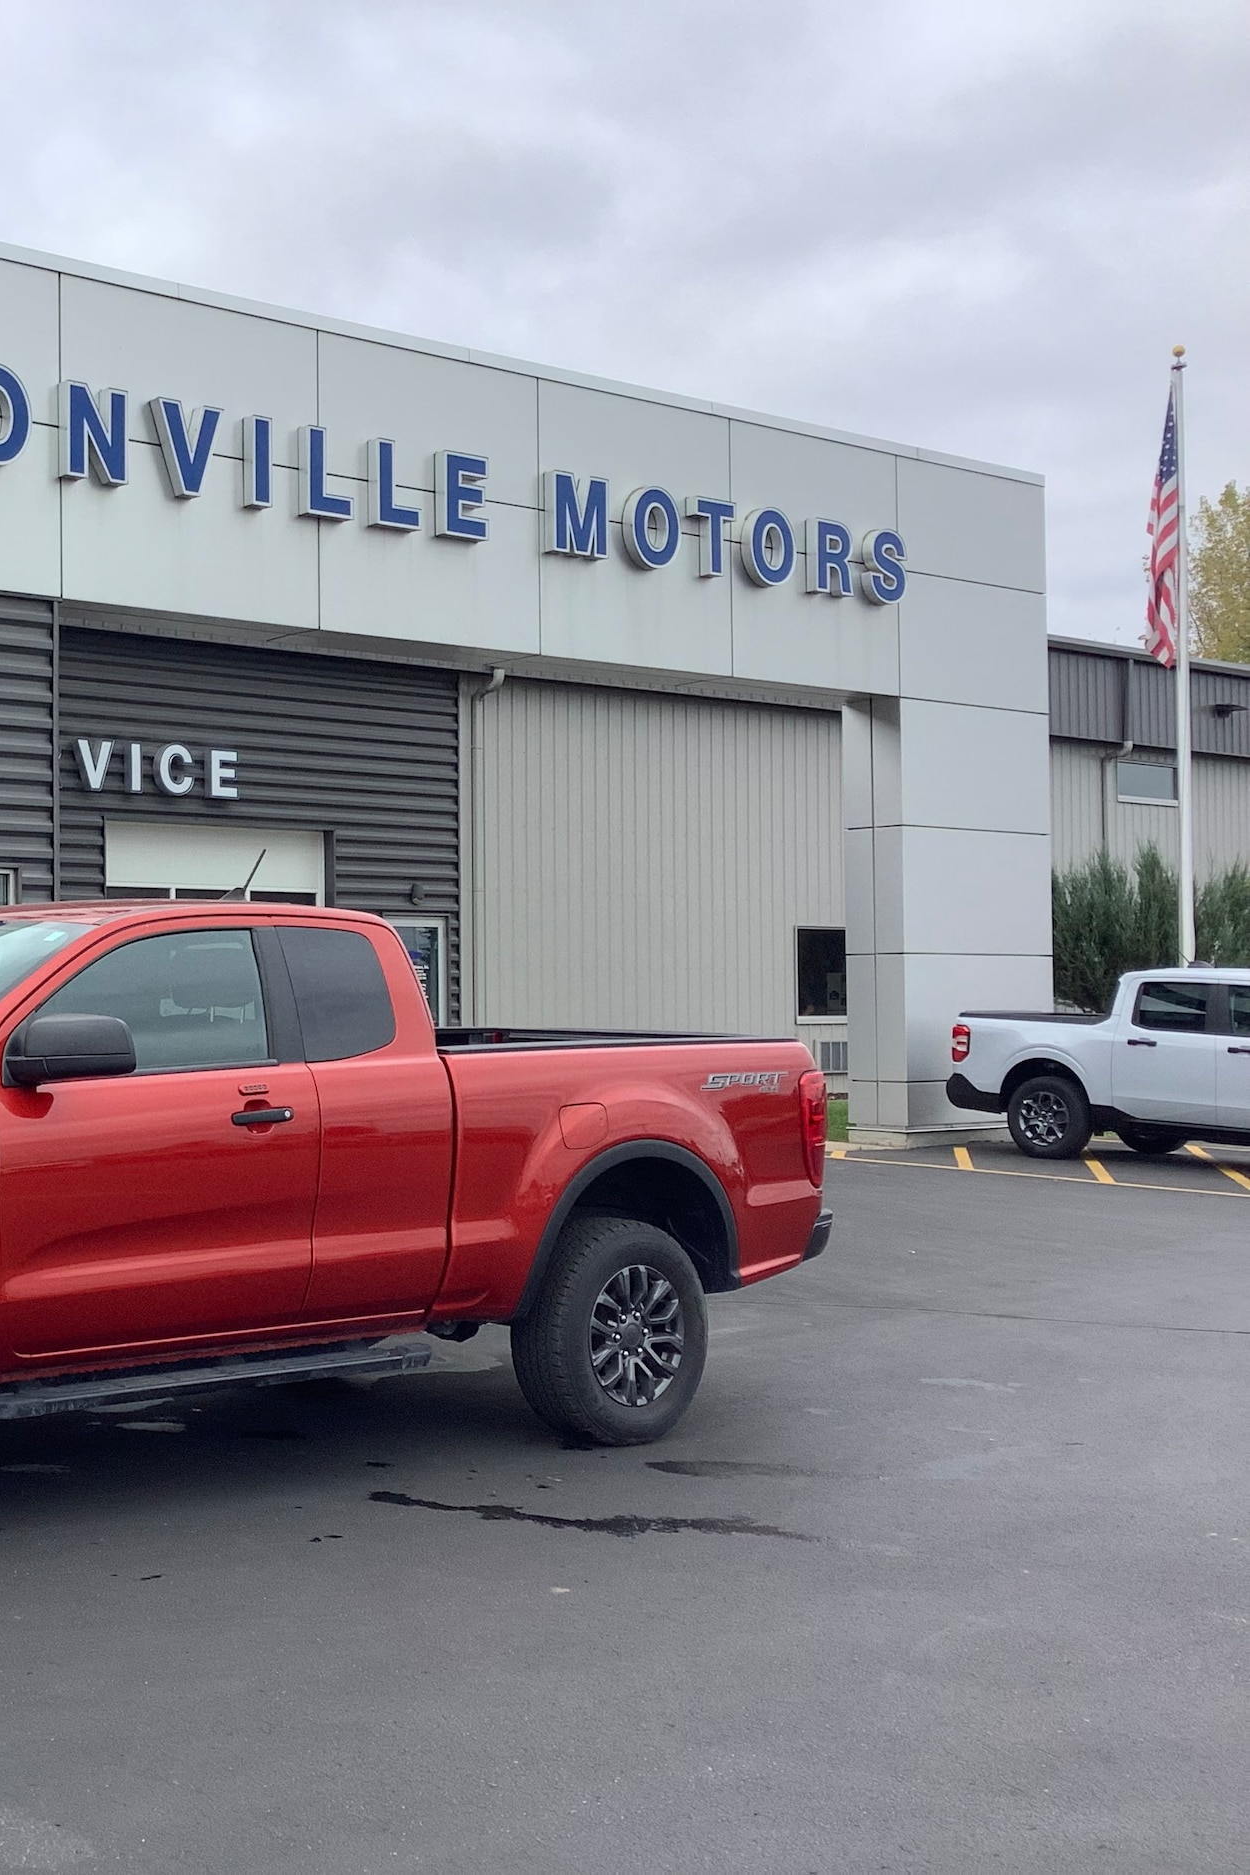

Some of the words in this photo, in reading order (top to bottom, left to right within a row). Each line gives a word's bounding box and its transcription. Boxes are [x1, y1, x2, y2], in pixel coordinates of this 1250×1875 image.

[543, 470, 908, 605] MOTORS
[74, 738, 239, 799] VICE
[700, 1071, 788, 1091] SPORT
